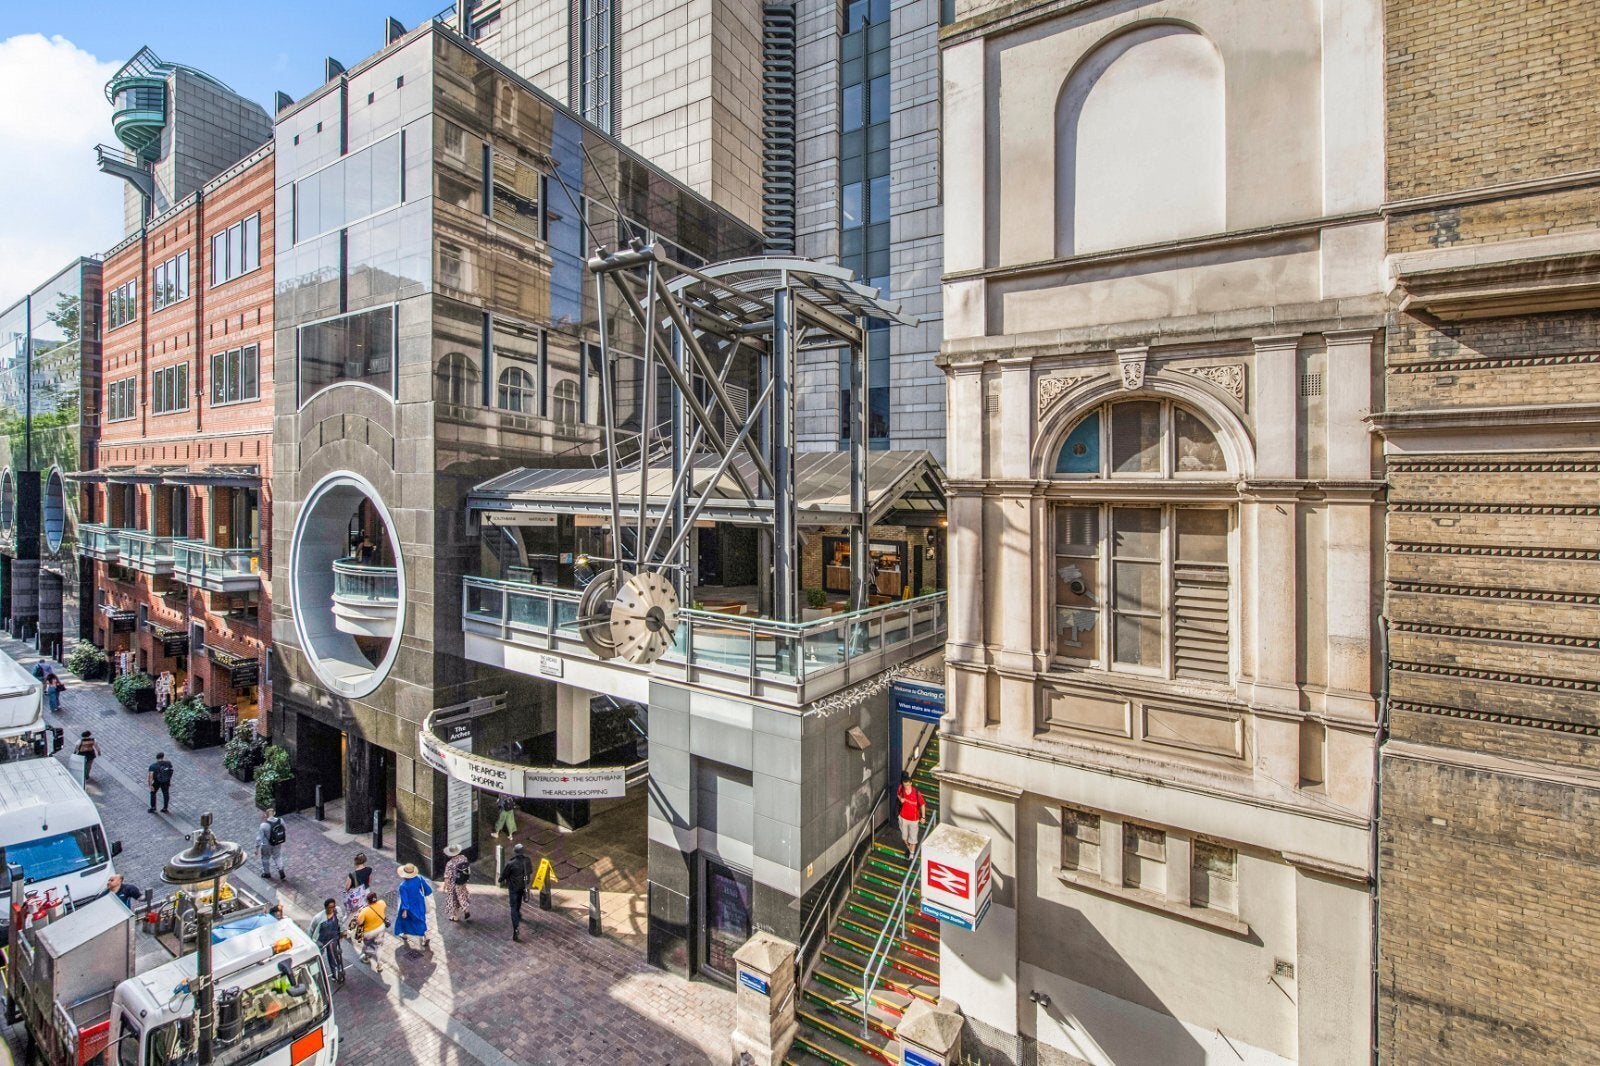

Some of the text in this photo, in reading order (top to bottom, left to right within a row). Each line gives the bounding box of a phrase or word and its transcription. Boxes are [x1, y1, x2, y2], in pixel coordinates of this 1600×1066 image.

[917, 689, 938, 699] Charing
[450, 730, 471, 740] Arches
[468, 763, 507, 780] THE ARCHES
[470, 774, 504, 790] SHOPPING
[527, 775, 560, 783] WATERLOO
[923, 906, 965, 925] Charing Cross Station
